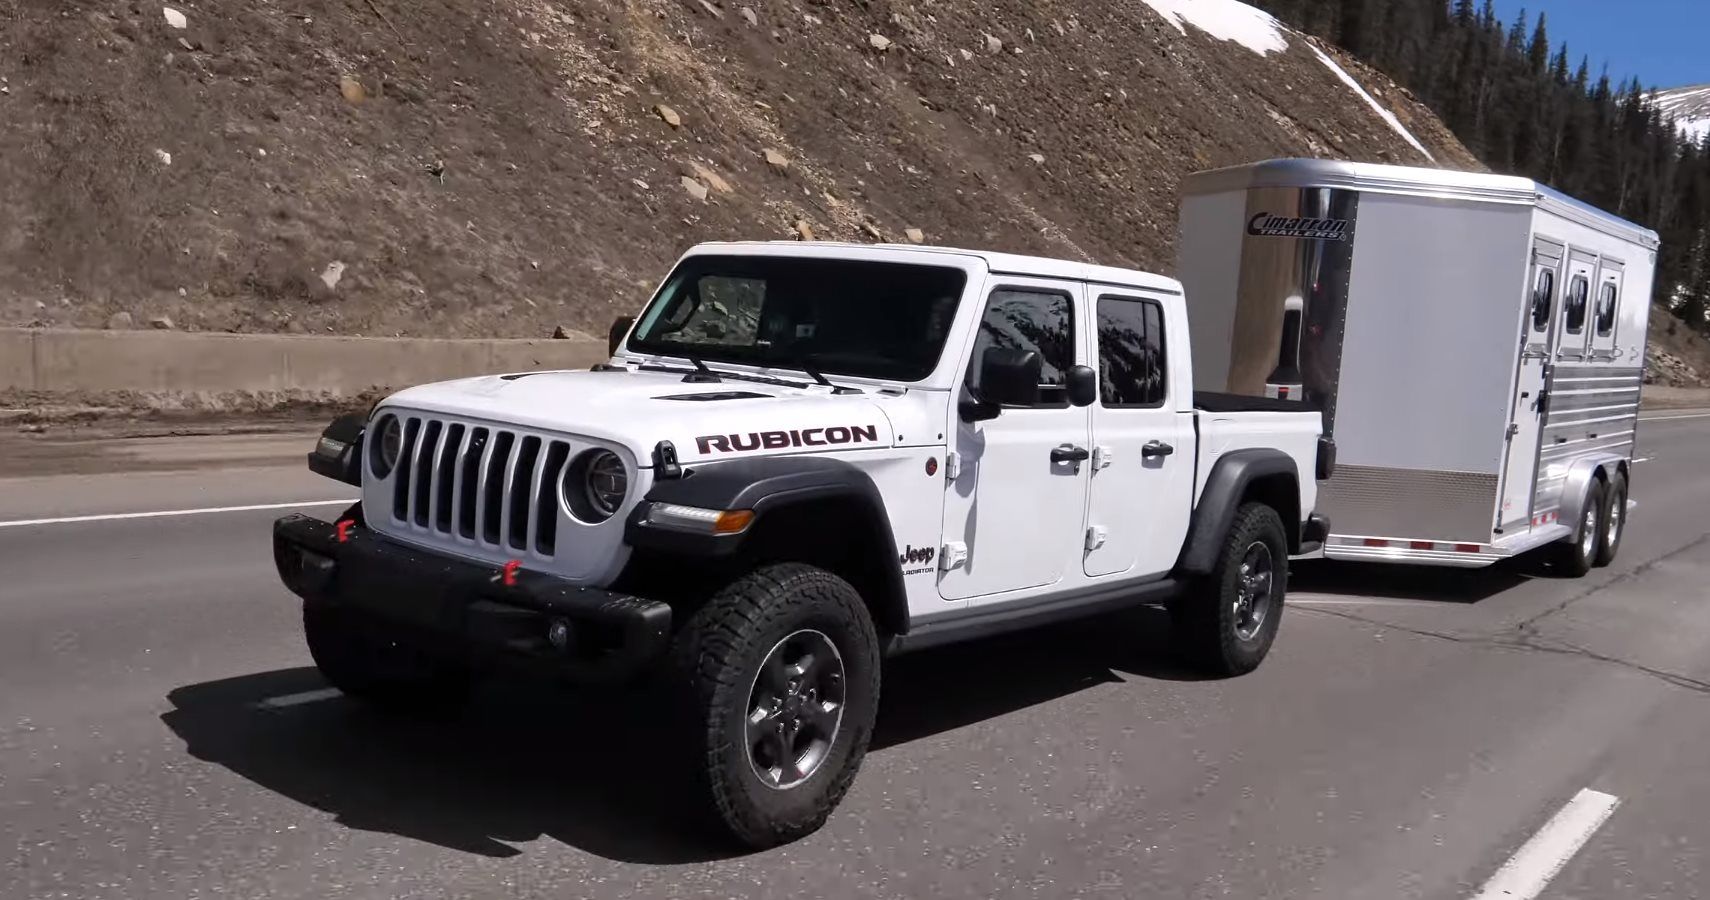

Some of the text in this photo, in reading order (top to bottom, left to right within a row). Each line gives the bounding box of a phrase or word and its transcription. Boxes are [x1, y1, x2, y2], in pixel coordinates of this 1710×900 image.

[1260, 229, 1338, 238] TRAILERS
[695, 425, 877, 454] RUBICON
[900, 545, 934, 565] Jeep
